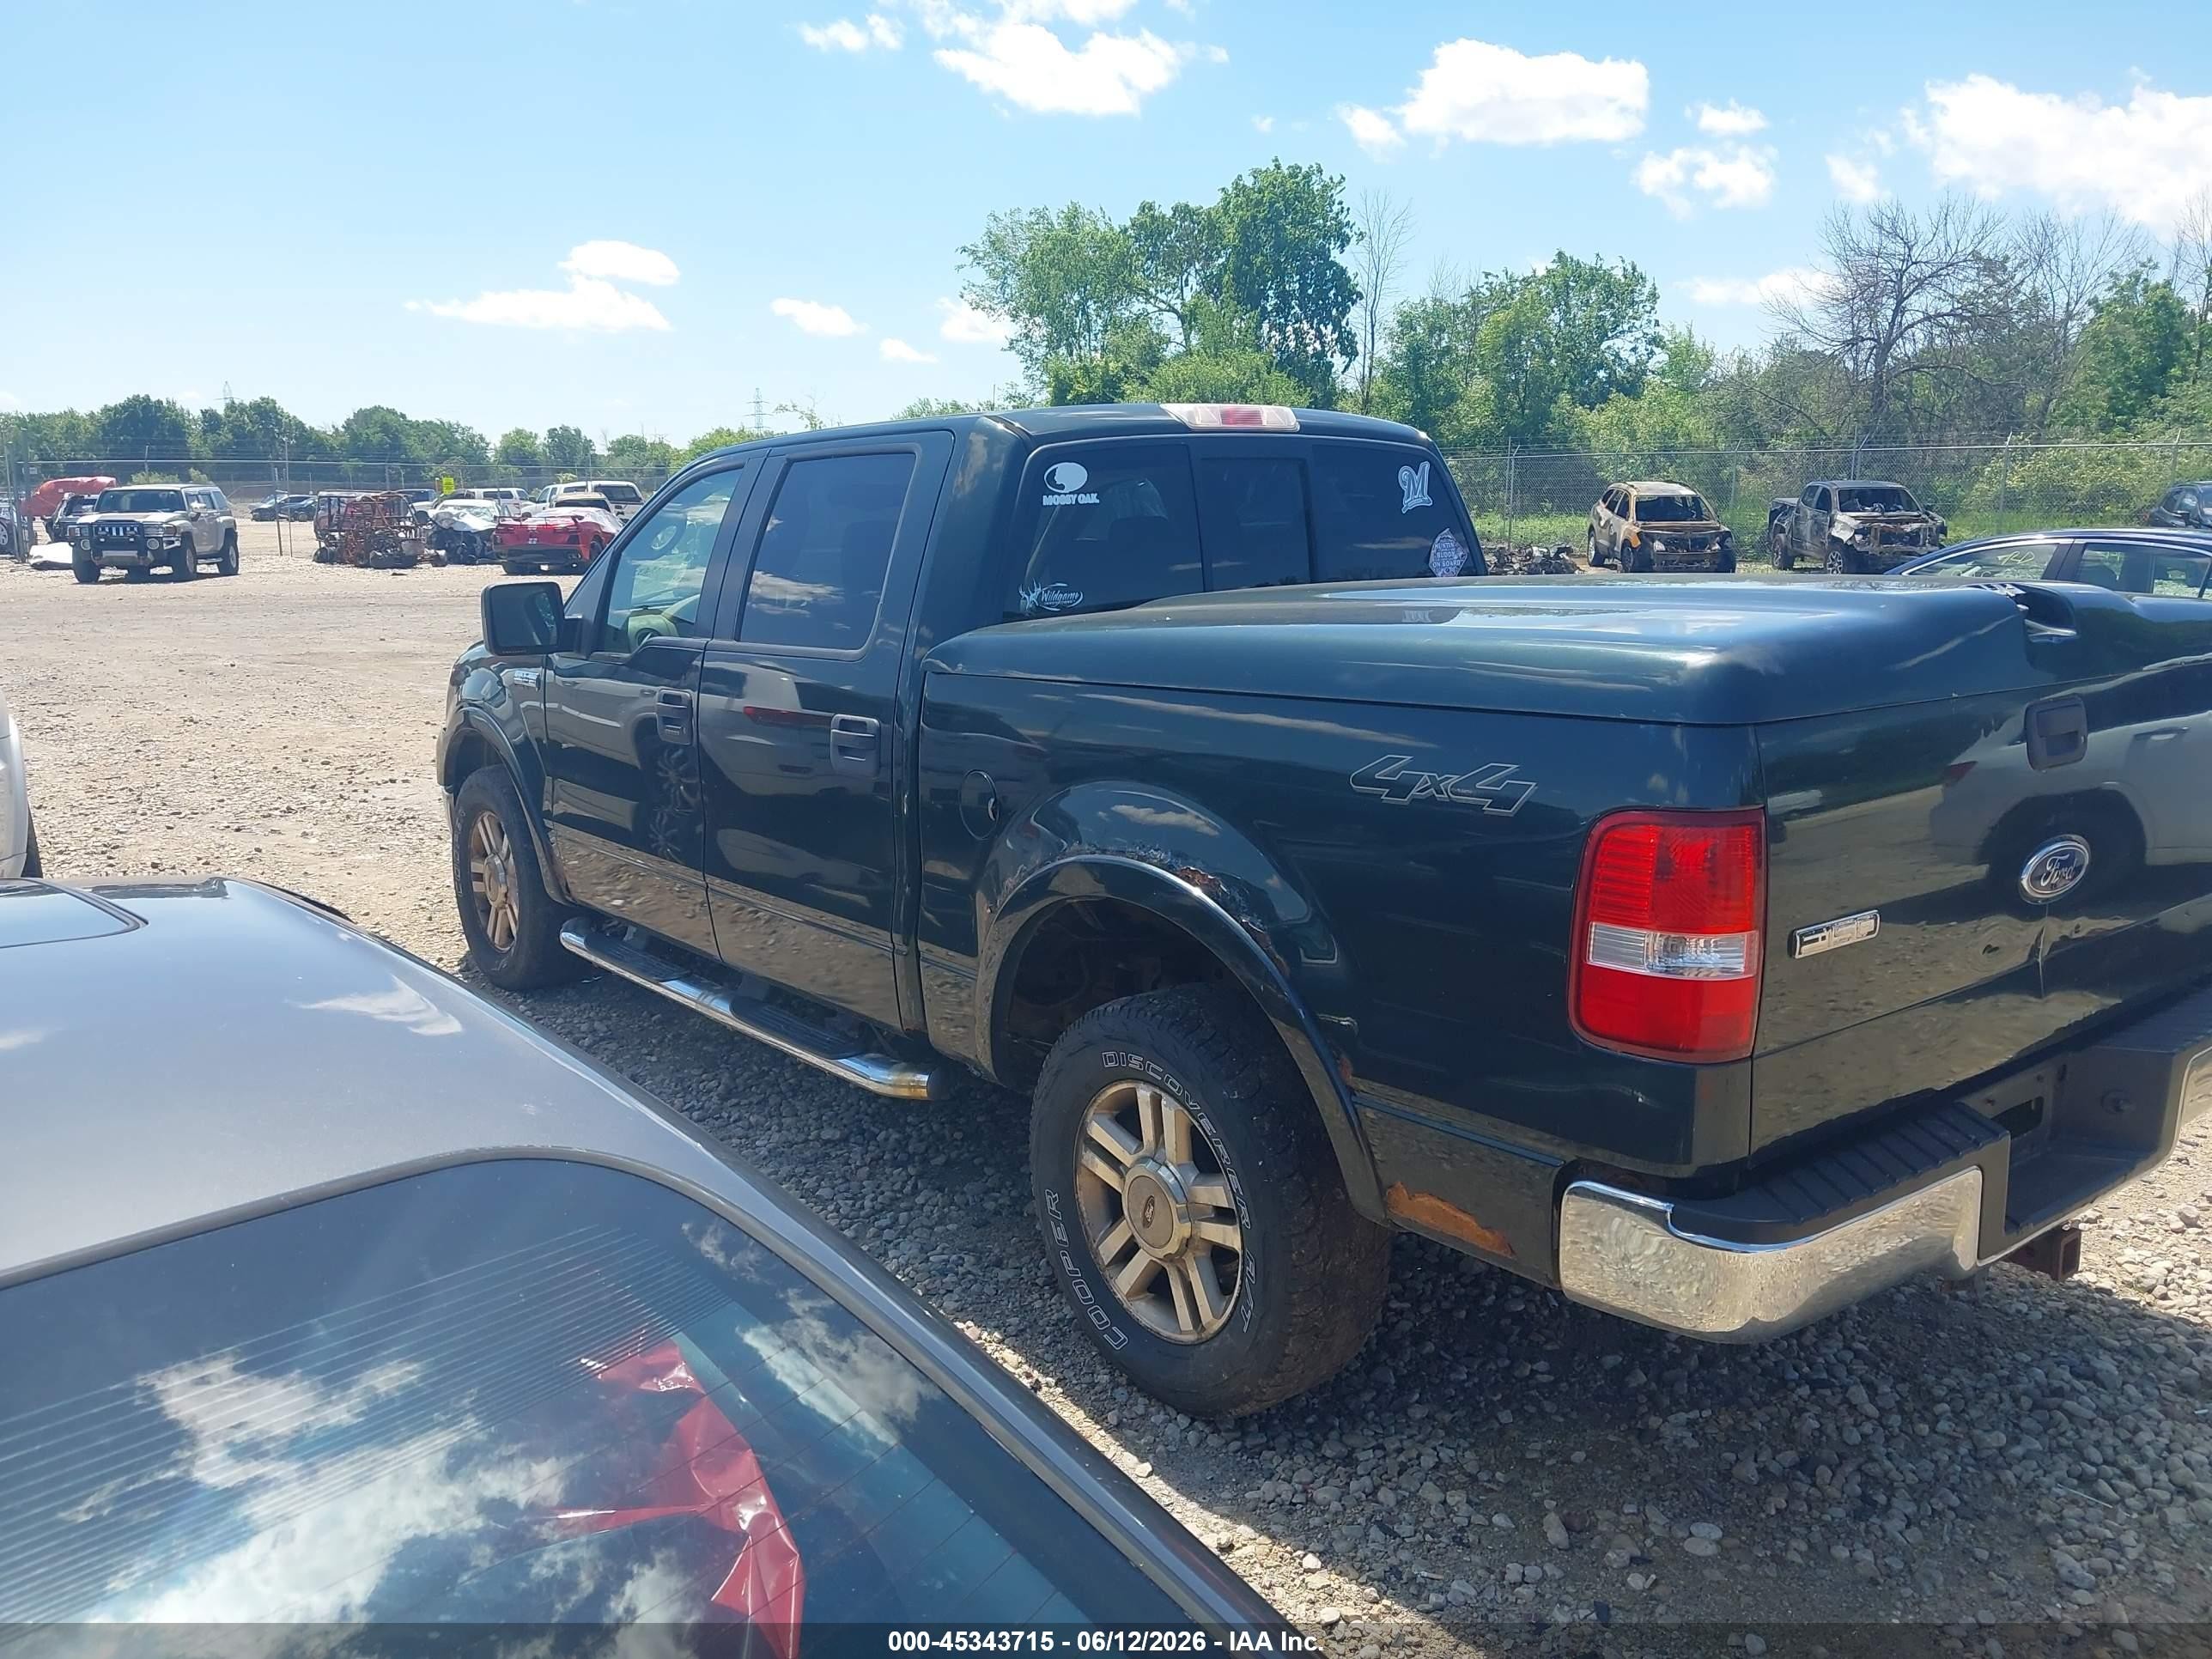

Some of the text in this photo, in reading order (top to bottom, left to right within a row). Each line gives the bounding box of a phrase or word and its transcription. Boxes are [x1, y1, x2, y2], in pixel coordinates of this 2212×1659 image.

[1042, 494, 1077, 506] MOSSY
[2040, 854, 2076, 886] Ford
[1101, 1051, 1251, 1230] DISCOVERER
[1044, 1188, 1128, 1351] COOPER
